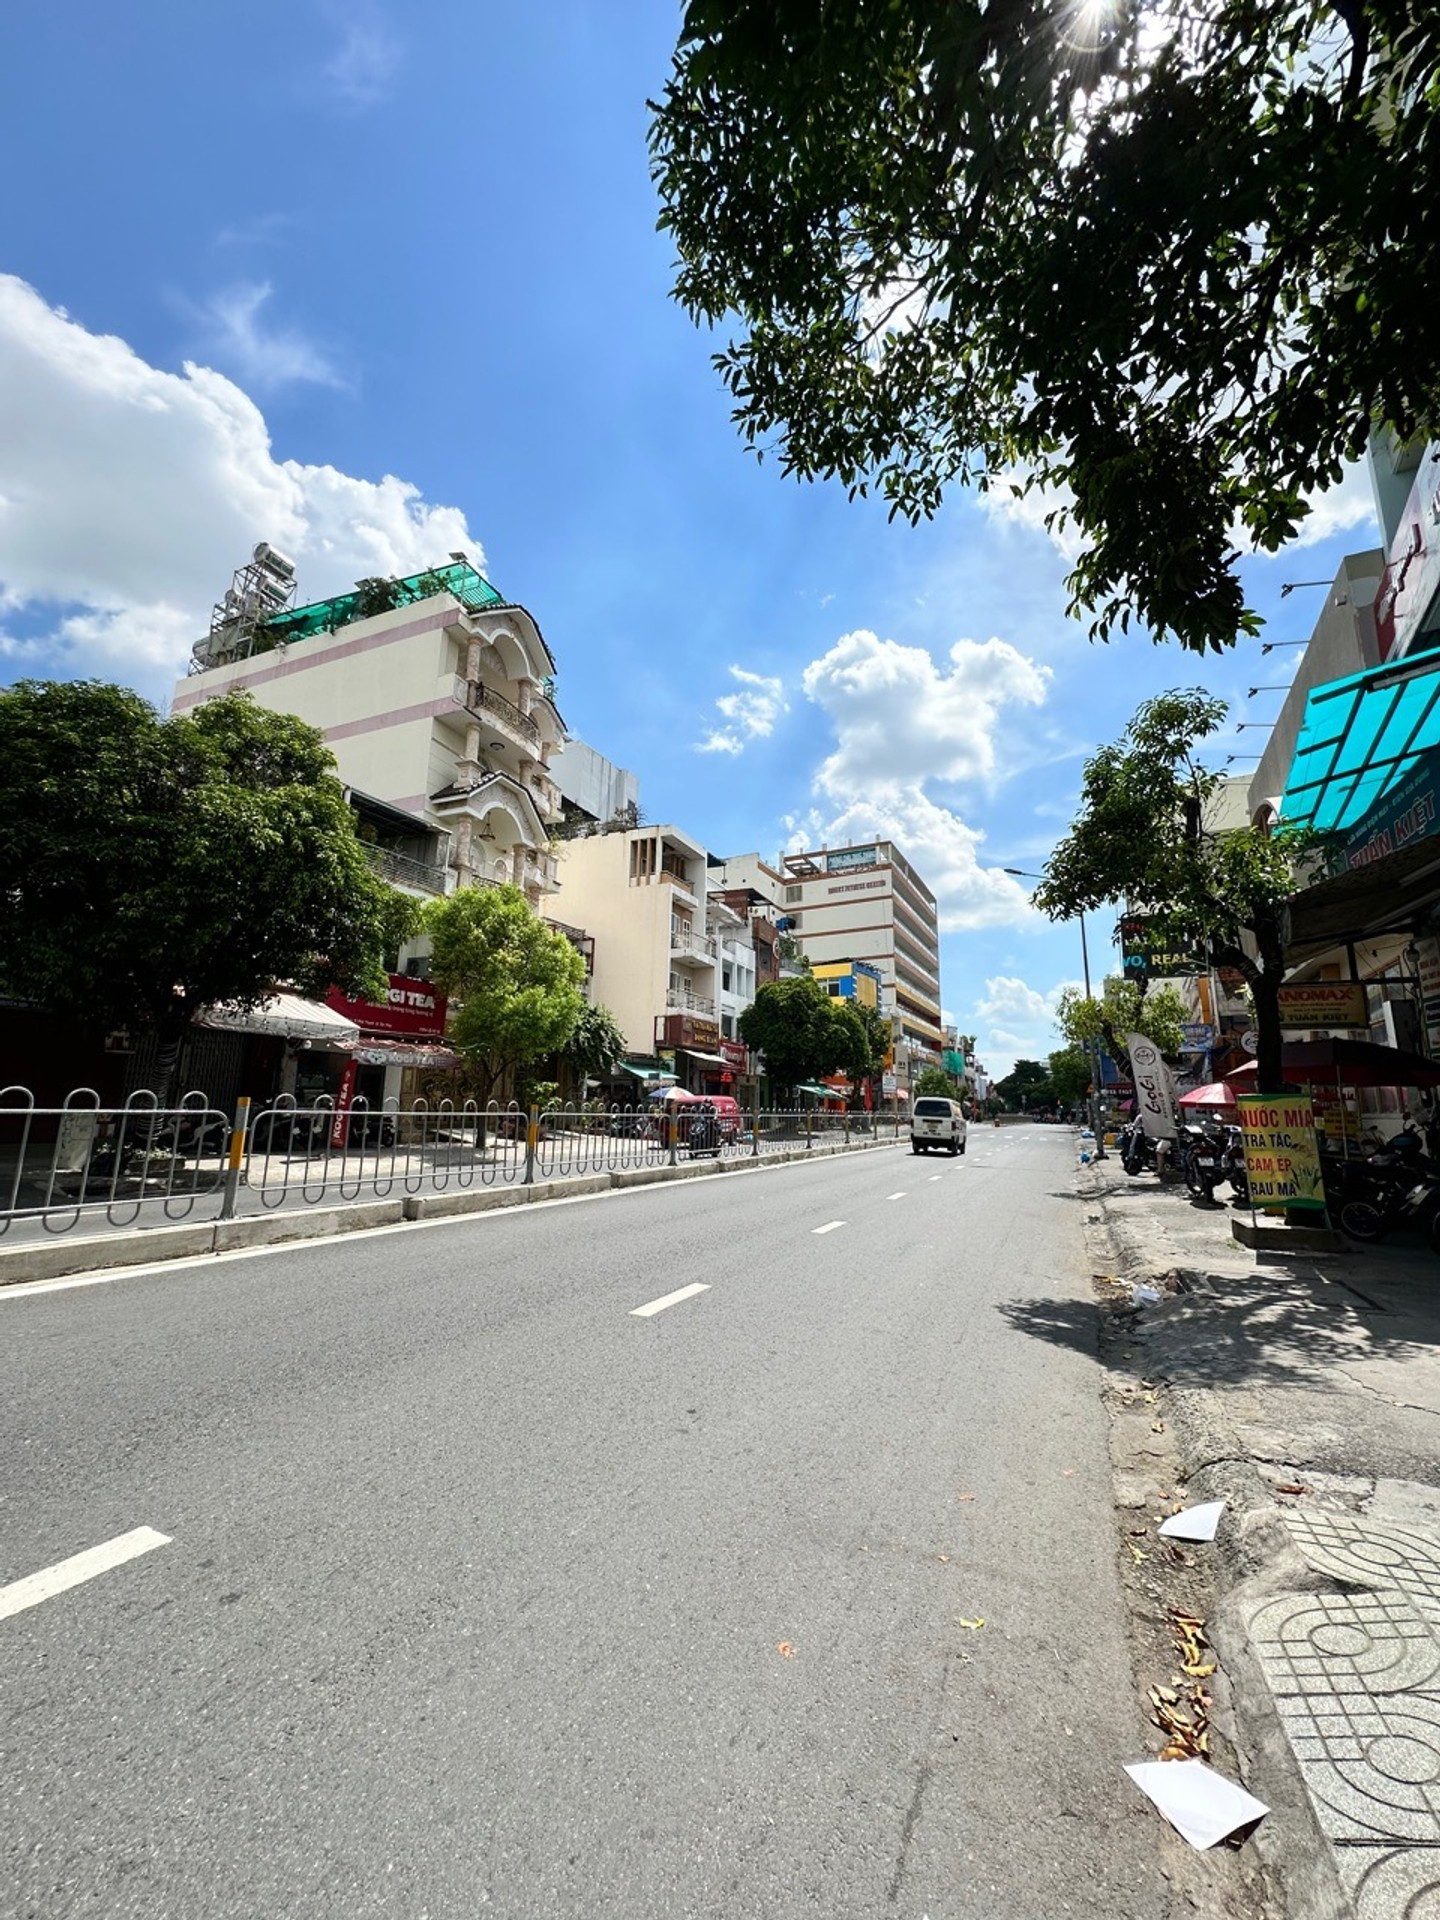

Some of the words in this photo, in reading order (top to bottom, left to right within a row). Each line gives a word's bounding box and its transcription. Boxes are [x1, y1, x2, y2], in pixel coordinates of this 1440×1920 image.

[407, 991, 435, 1009] TEA
[1278, 987, 1354, 1002] ANOMAX
[333, 1110, 343, 1138] KOG
[1239, 1105, 1279, 1128] NƯỚC
[1284, 1105, 1315, 1128] MÍA
[1243, 1130, 1266, 1148] TRÀ
[1246, 1157, 1273, 1171] CAM
[1277, 1155, 1292, 1172] ÉP
[1249, 1181, 1273, 1197] RAU
[1277, 1179, 1297, 1197] MÁ
